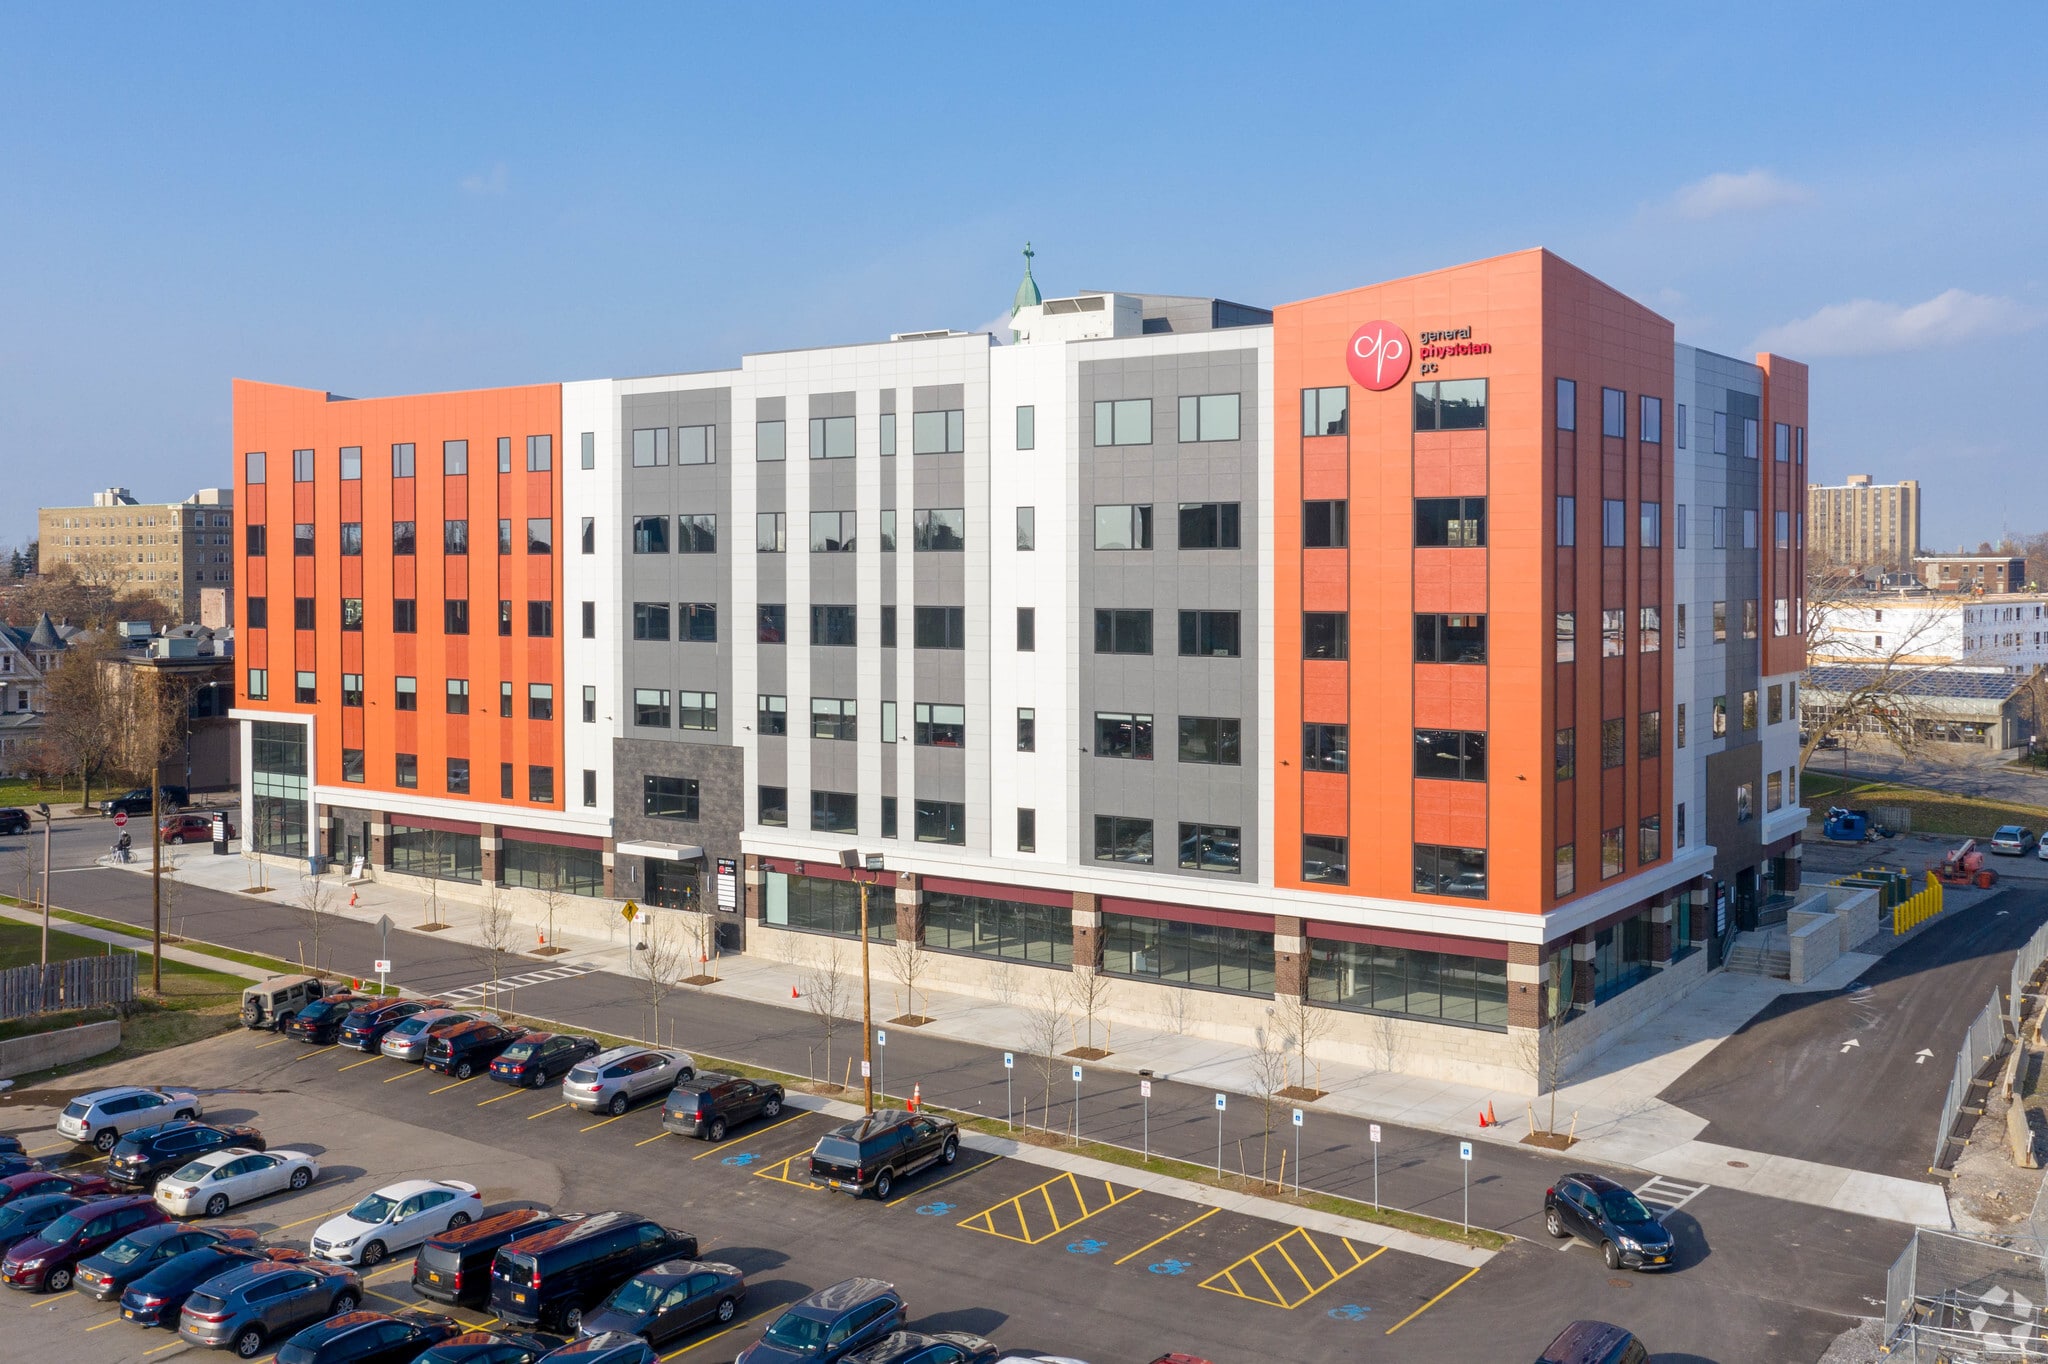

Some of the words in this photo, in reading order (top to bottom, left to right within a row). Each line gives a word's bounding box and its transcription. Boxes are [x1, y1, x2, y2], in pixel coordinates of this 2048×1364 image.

[1420, 326, 1471, 345] general
[1420, 342, 1492, 361] physician
[1420, 362, 1439, 376] pc
